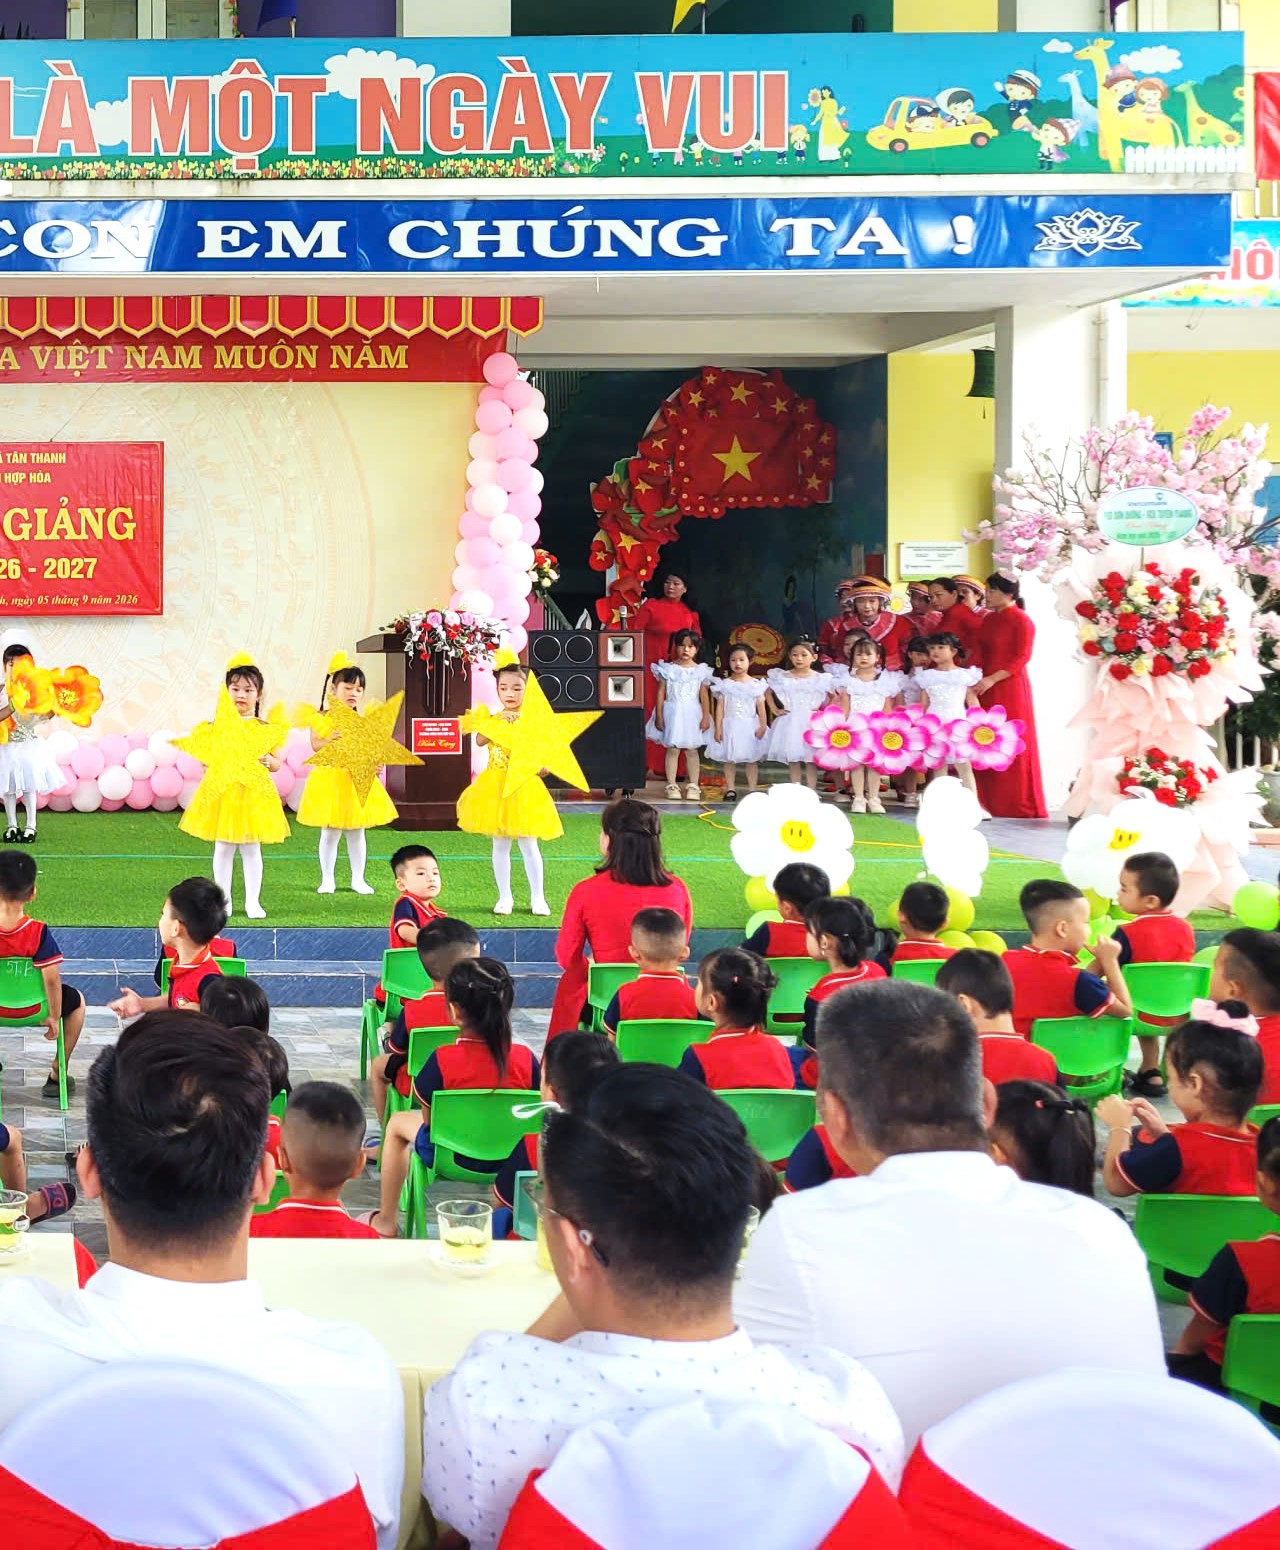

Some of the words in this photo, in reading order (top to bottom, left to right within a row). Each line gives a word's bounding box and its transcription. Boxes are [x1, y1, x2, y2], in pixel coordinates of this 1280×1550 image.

[128, 58, 330, 174] MỘT
[356, 56, 612, 154] NGÀY
[635, 71, 789, 152] VUI
[197, 219, 347, 259] EM
[388, 206, 728, 259] CHÚNG
[770, 216, 909, 256] TA
[951, 215, 975, 255] !
[31, 340, 114, 377] VIỆT
[123, 345, 202, 369] NAM
[213, 339, 319, 369] MUÔN
[330, 337, 408, 369] NĂM
[6, 451, 27, 464] TÂN
[30, 452, 66, 464] THANH
[2, 496, 137, 541] GIẢNG
[43, 557, 98, 579] 2027
[11, 596, 35, 607] ngày
[37, 595, 49, 605] 05
[51, 595, 80, 606] tháng
[82, 594, 89, 604] 9
[90, 595, 112, 604] năm
[115, 594, 138, 604] 2026
